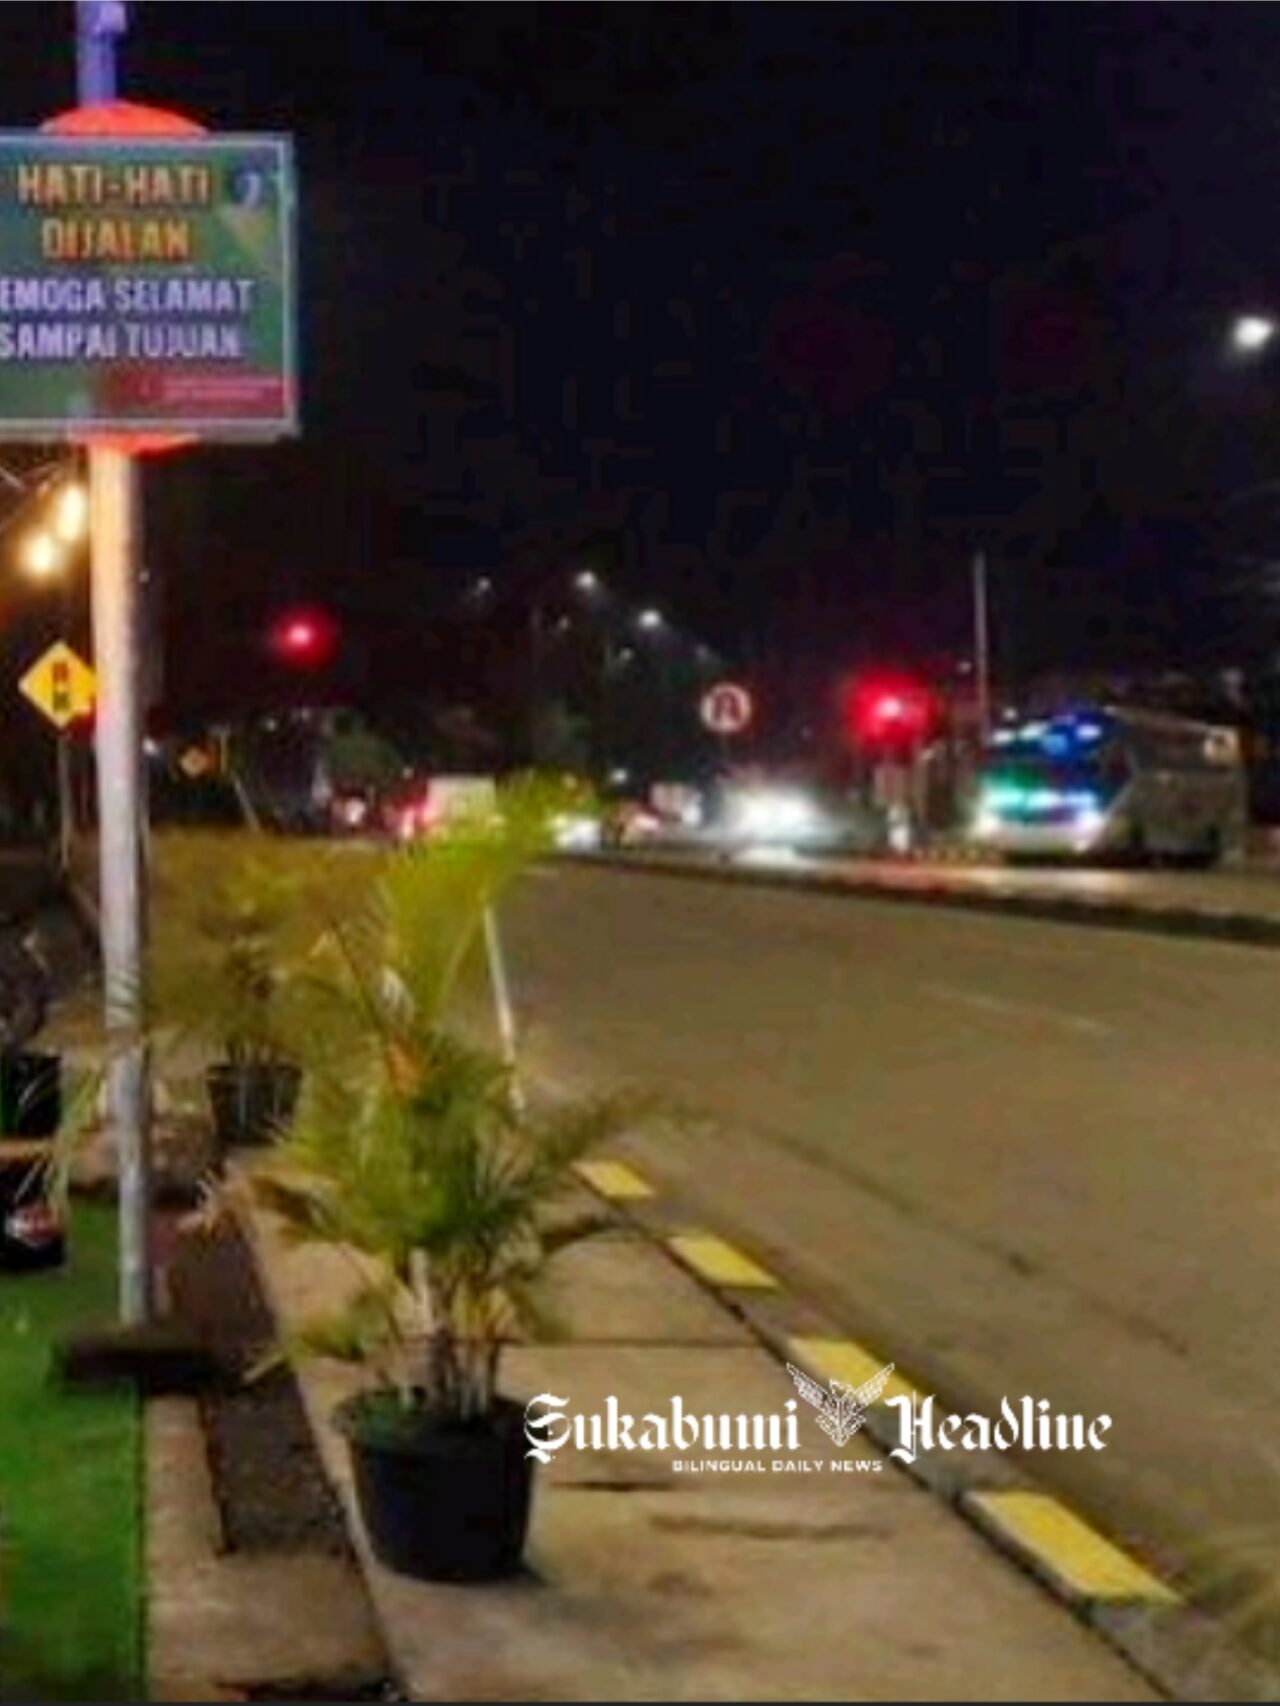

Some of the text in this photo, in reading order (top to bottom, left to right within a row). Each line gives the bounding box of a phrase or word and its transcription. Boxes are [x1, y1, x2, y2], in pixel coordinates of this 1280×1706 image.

[18, 164, 210, 206] HATI-HATI
[42, 218, 189, 259] DIJALAN
[114, 278, 254, 312] SELAMAT
[127, 323, 242, 358] TUJUAN
